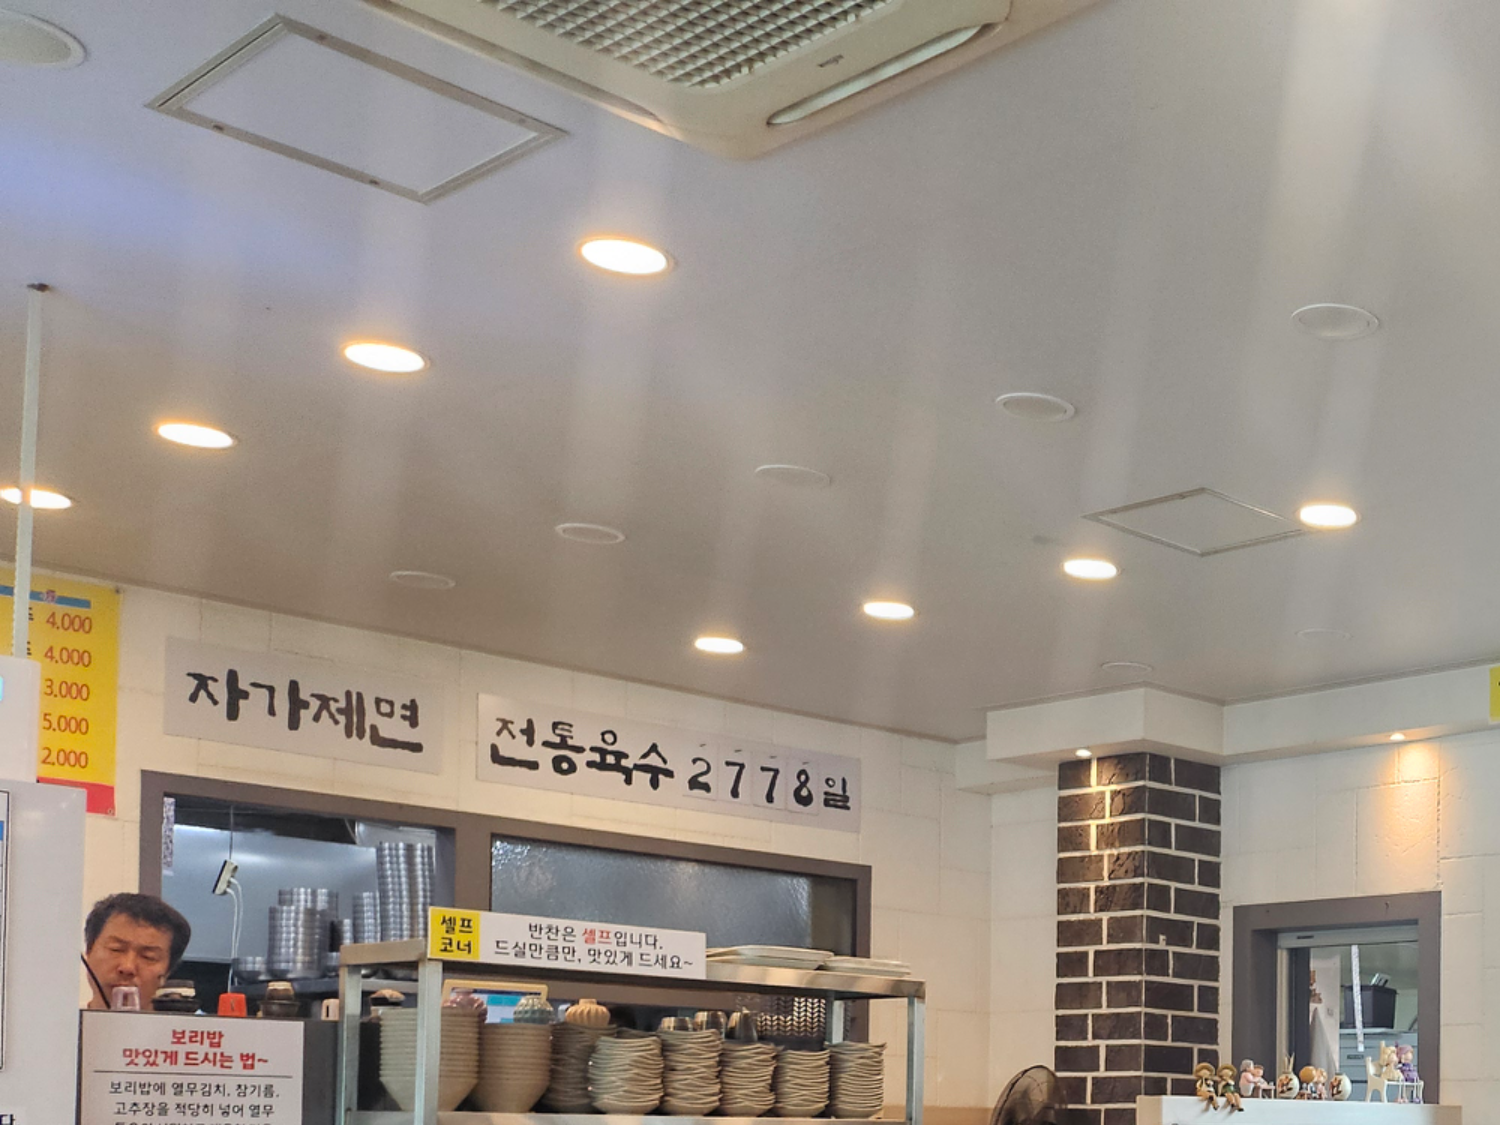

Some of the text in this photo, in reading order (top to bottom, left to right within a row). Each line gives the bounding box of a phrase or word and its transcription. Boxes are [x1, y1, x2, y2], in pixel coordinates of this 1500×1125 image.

[45, 611, 93, 634] 4.000
[44, 645, 92, 668] 4.000
[43, 678, 91, 701] 3.000
[186, 668, 424, 754] 자가제면
[42, 712, 90, 735] 5.000
[40, 746, 89, 769] 2.000
[492, 717, 674, 791] 전통육수
[440, 914, 473, 935] 셀프
[528, 922, 664, 950] 반찬은 셀프입니다.
[439, 937, 472, 955] 코너
[494, 939, 693, 970] 드실만큼만, 맛있게 드세요~
[171, 1029, 225, 1048] 보리밥
[122, 1048, 179, 1067] 맛있게
[183, 1051, 235, 1069] 드시는
[109, 1080, 166, 1097] 보리밥에
[113, 1102, 275, 1118] 고추장을 적당히 넣어 열무
